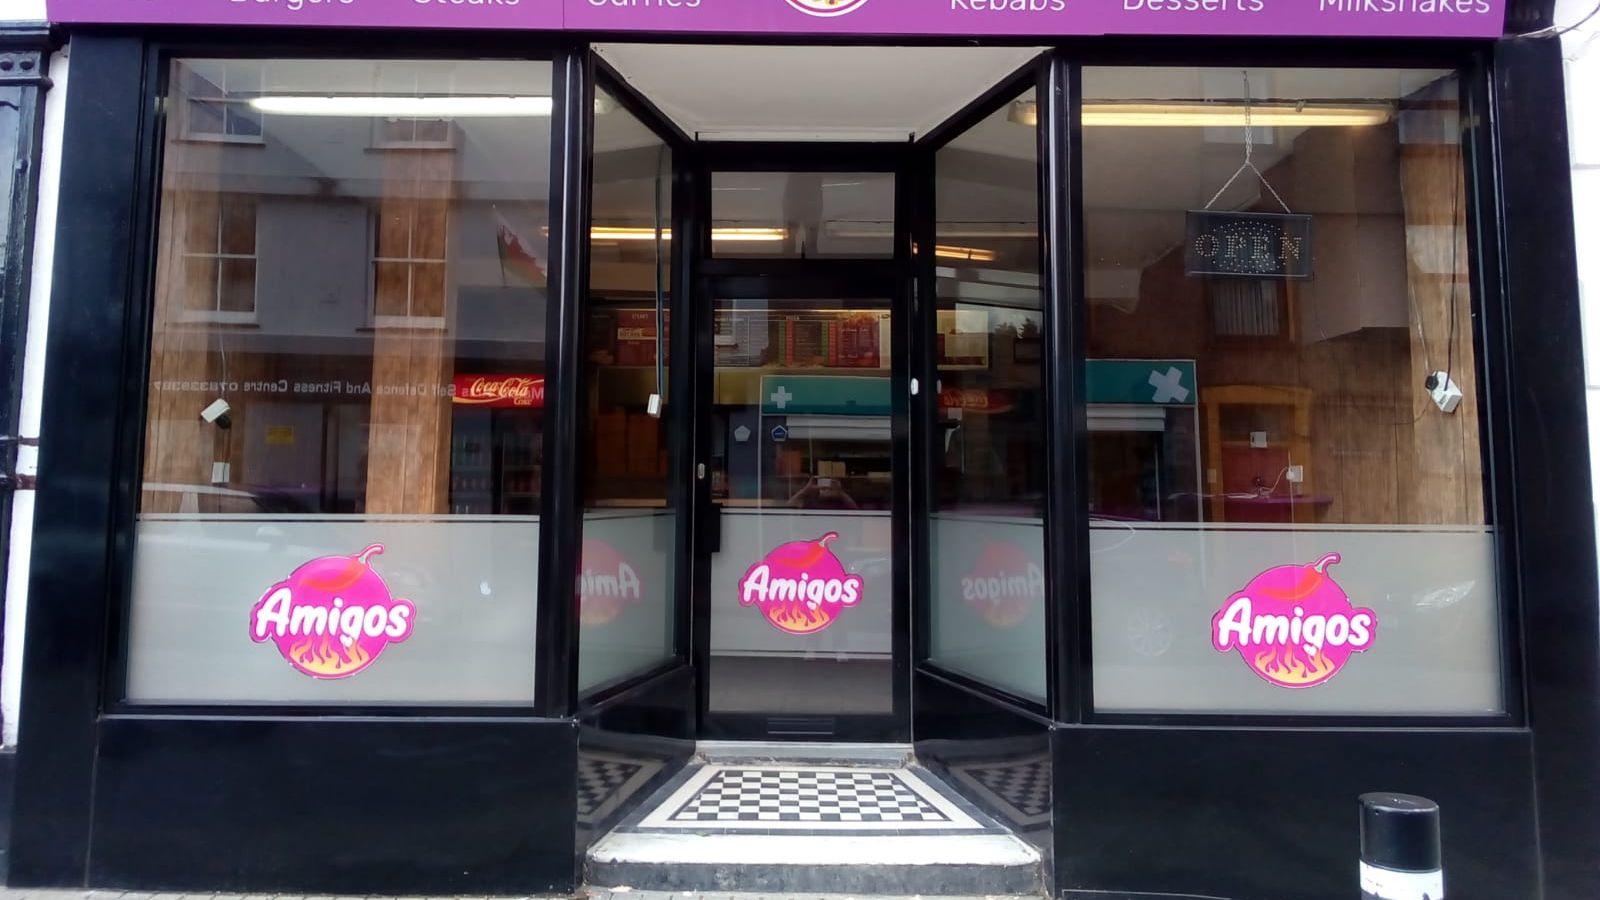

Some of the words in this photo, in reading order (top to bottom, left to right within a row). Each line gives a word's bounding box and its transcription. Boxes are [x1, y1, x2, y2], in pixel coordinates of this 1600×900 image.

[255, 587, 412, 648] Amigos
[743, 564, 860, 611] Amigos
[1218, 596, 1372, 656] Amigos
